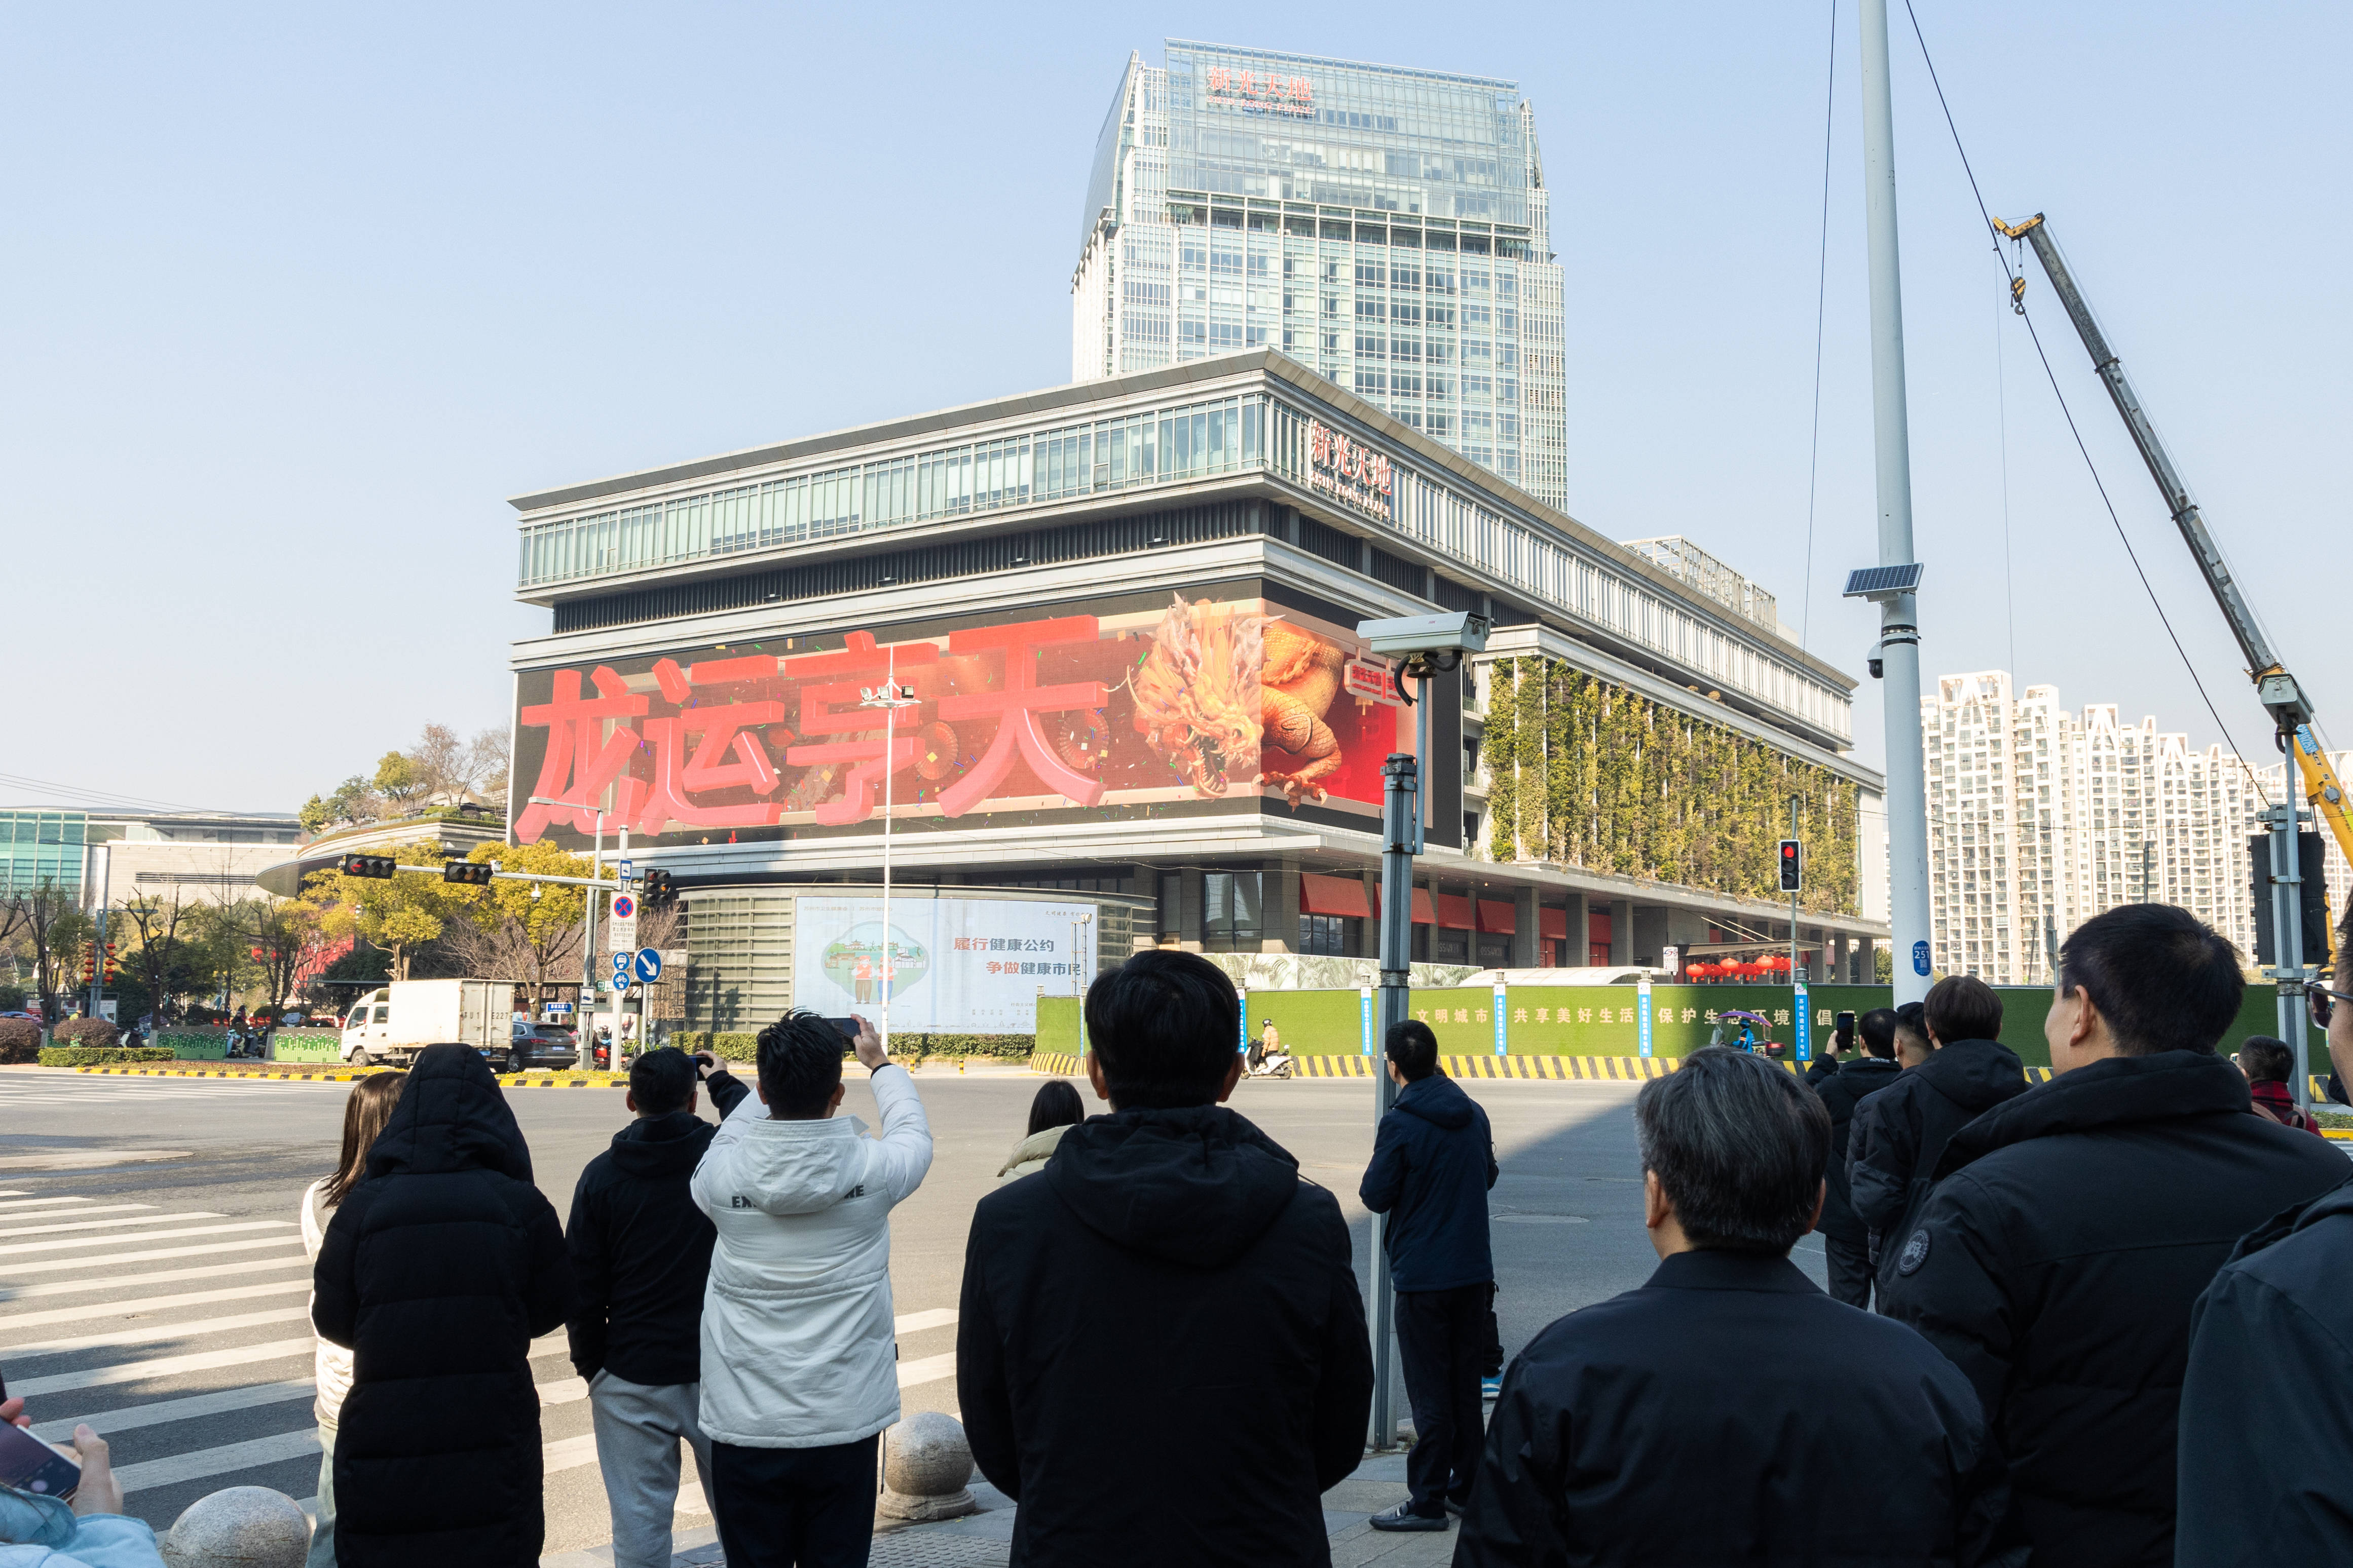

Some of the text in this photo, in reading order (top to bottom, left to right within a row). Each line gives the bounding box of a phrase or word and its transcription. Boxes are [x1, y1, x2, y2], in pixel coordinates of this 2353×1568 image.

[1207, 66, 1312, 101] 新光天地
[1208, 96, 1310, 114] SHIN KONG PLACE
[1311, 420, 1392, 495] 新光天地
[1336, 482, 1362, 504] KONG
[953, 937, 1055, 952] 履行健康公约
[1914, 950, 1930, 959] 251
[986, 961, 1081, 976] 争做健康市民
[1415, 1008, 1489, 1024] 文明城市
[1514, 1007, 1635, 1024] 共享美好生活
[732, 1196, 757, 1208] EX
